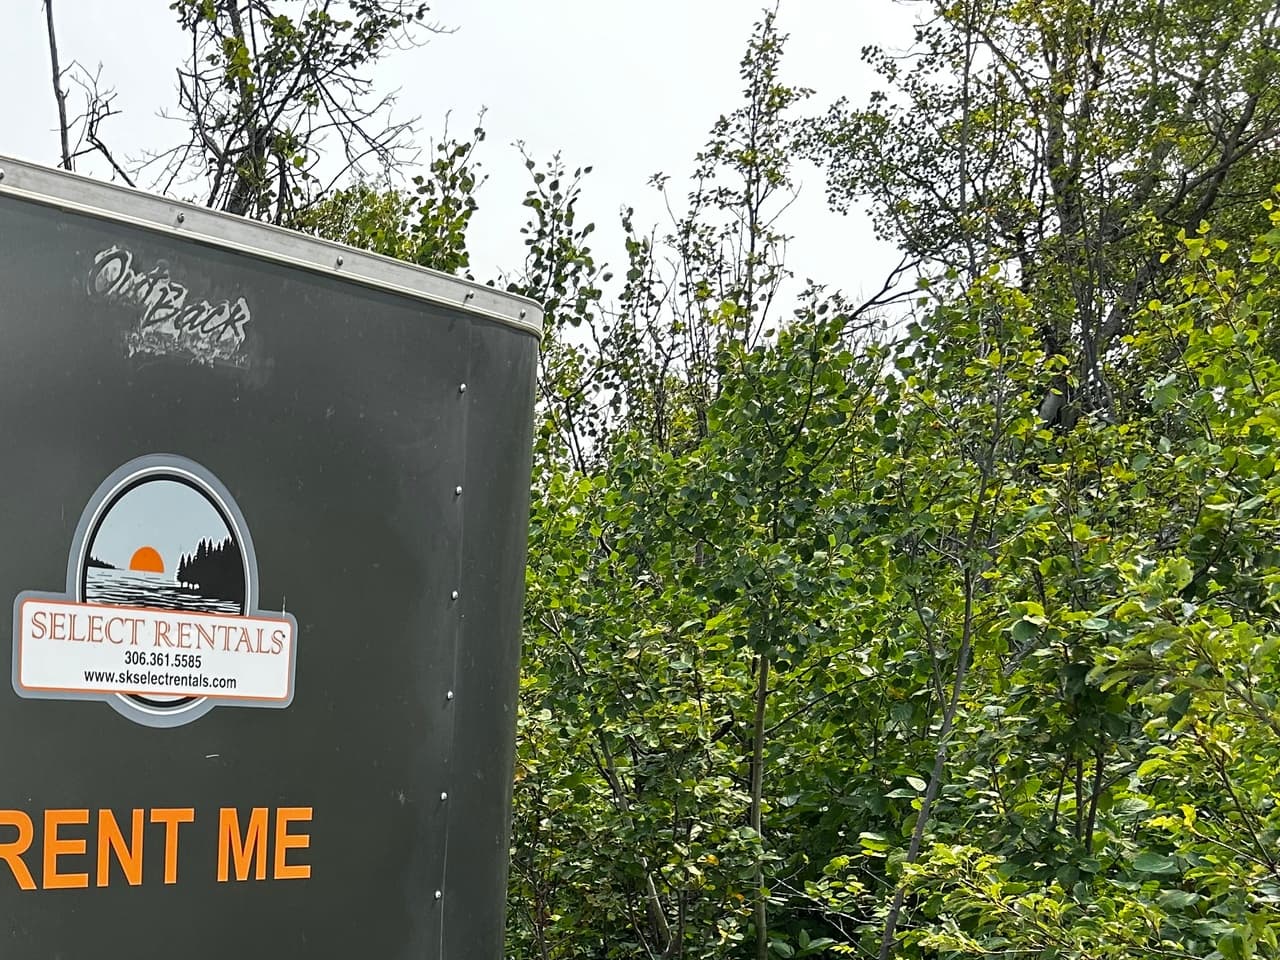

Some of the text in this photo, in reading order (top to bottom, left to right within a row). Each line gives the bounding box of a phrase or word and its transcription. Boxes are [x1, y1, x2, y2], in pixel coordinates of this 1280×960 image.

[31, 611, 286, 655] SELECT RENTALS
[124, 651, 202, 669] 306.361.5585
[84, 670, 237, 690] www.skselectrentals.com
[217, 807, 313, 882] ME
